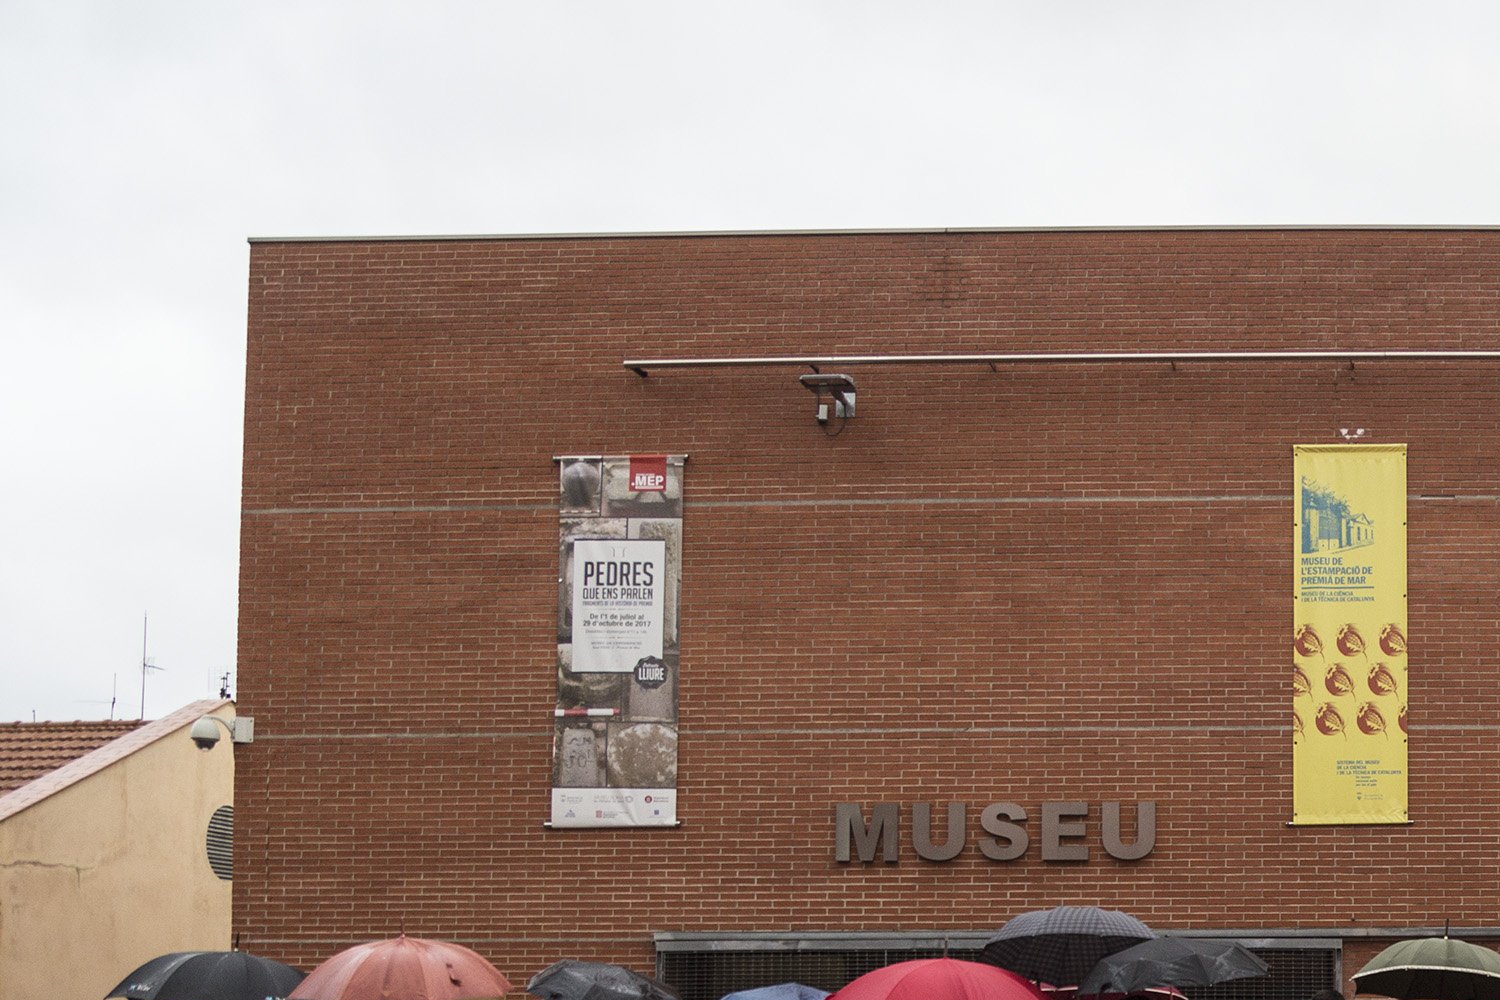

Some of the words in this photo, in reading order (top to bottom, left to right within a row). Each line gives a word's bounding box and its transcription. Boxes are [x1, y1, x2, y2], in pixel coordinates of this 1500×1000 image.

[1301, 557, 1330, 565] MUSEU
[1332, 557, 1343, 565] DE
[584, 562, 654, 586] PEDRES
[1362, 566, 1373, 574] DE
[1335, 576, 1346, 584] DE
[1347, 576, 1366, 584] MAR
[583, 588, 600, 599] QUE
[602, 588, 618, 599] ENS
[621, 588, 653, 599] PARLEN
[638, 667, 664, 680] LLIURE
[835, 801, 1156, 862] MUSEU
